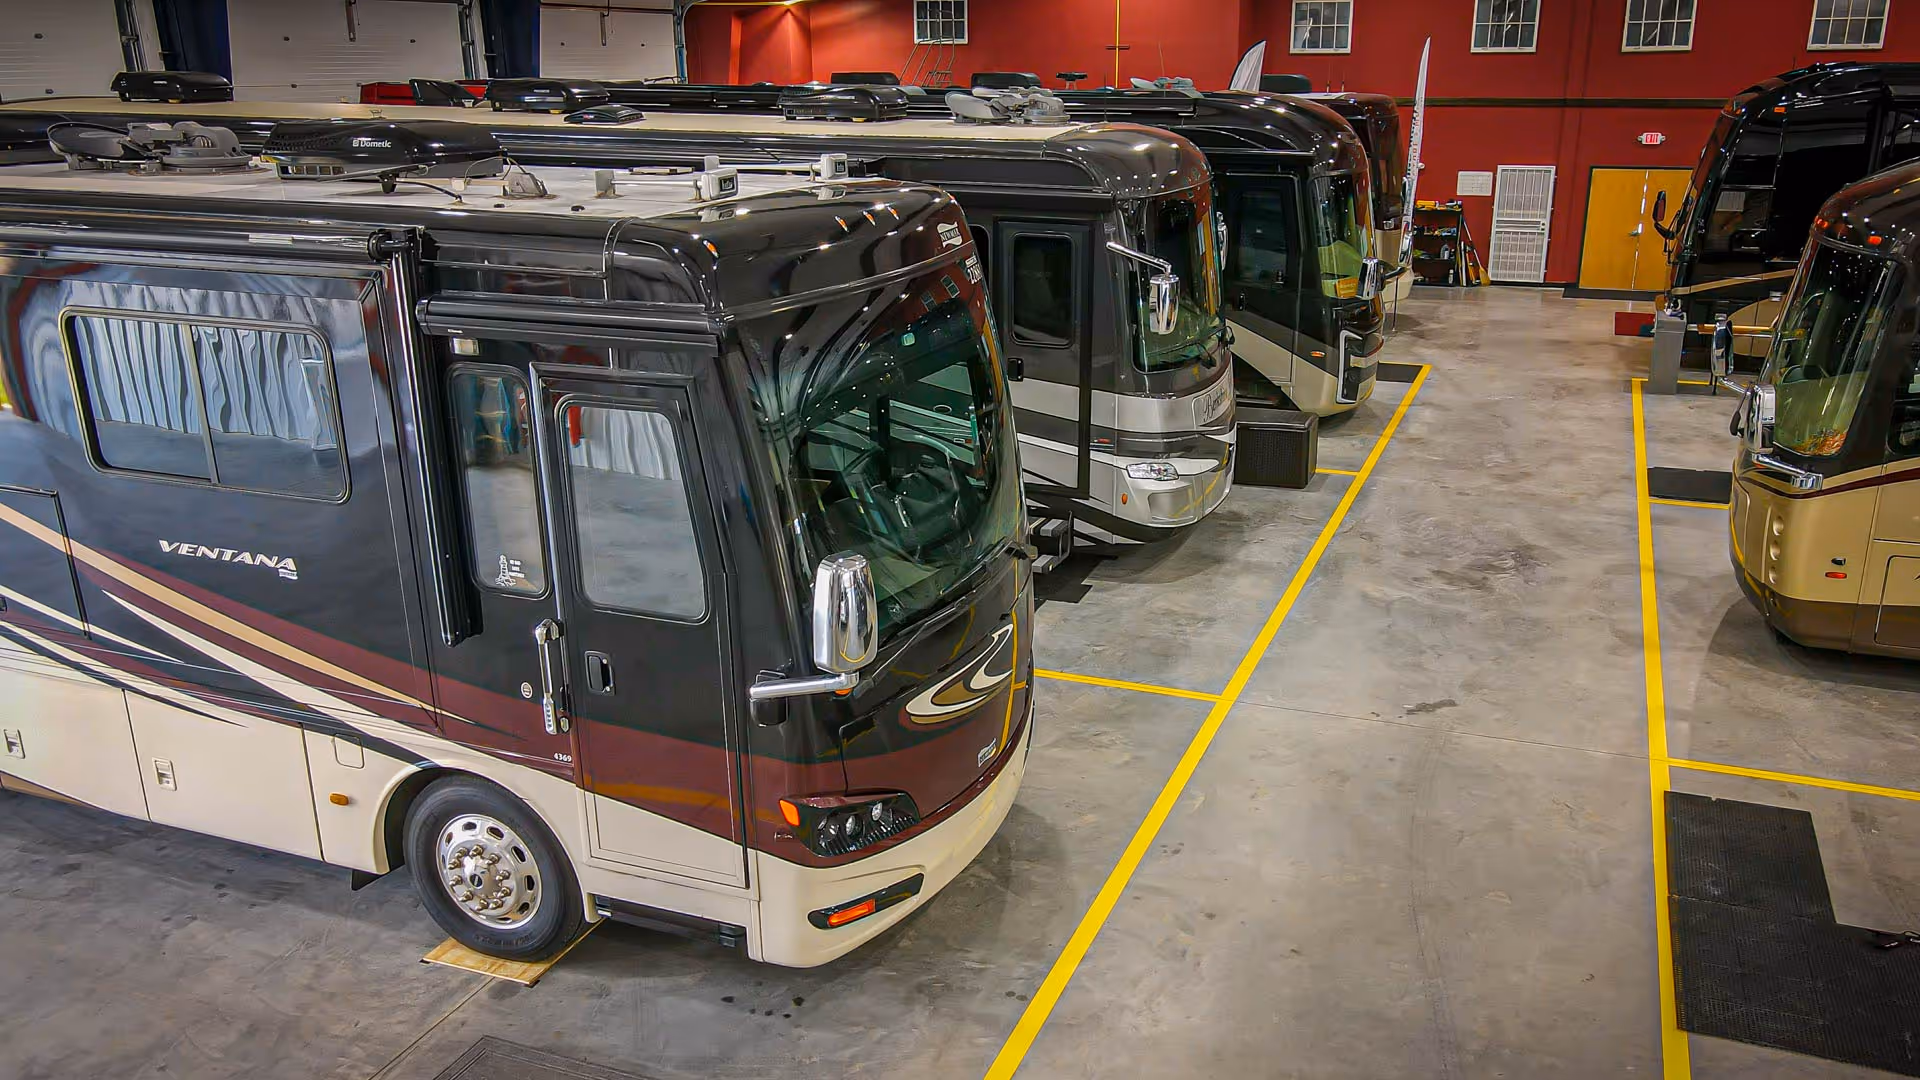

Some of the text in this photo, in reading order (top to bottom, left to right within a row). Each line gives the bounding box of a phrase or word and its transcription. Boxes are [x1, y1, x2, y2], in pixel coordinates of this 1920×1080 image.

[360, 140, 392, 148] Dometic
[159, 539, 297, 571] VENTANA
[553, 752, 572, 762] 4369
